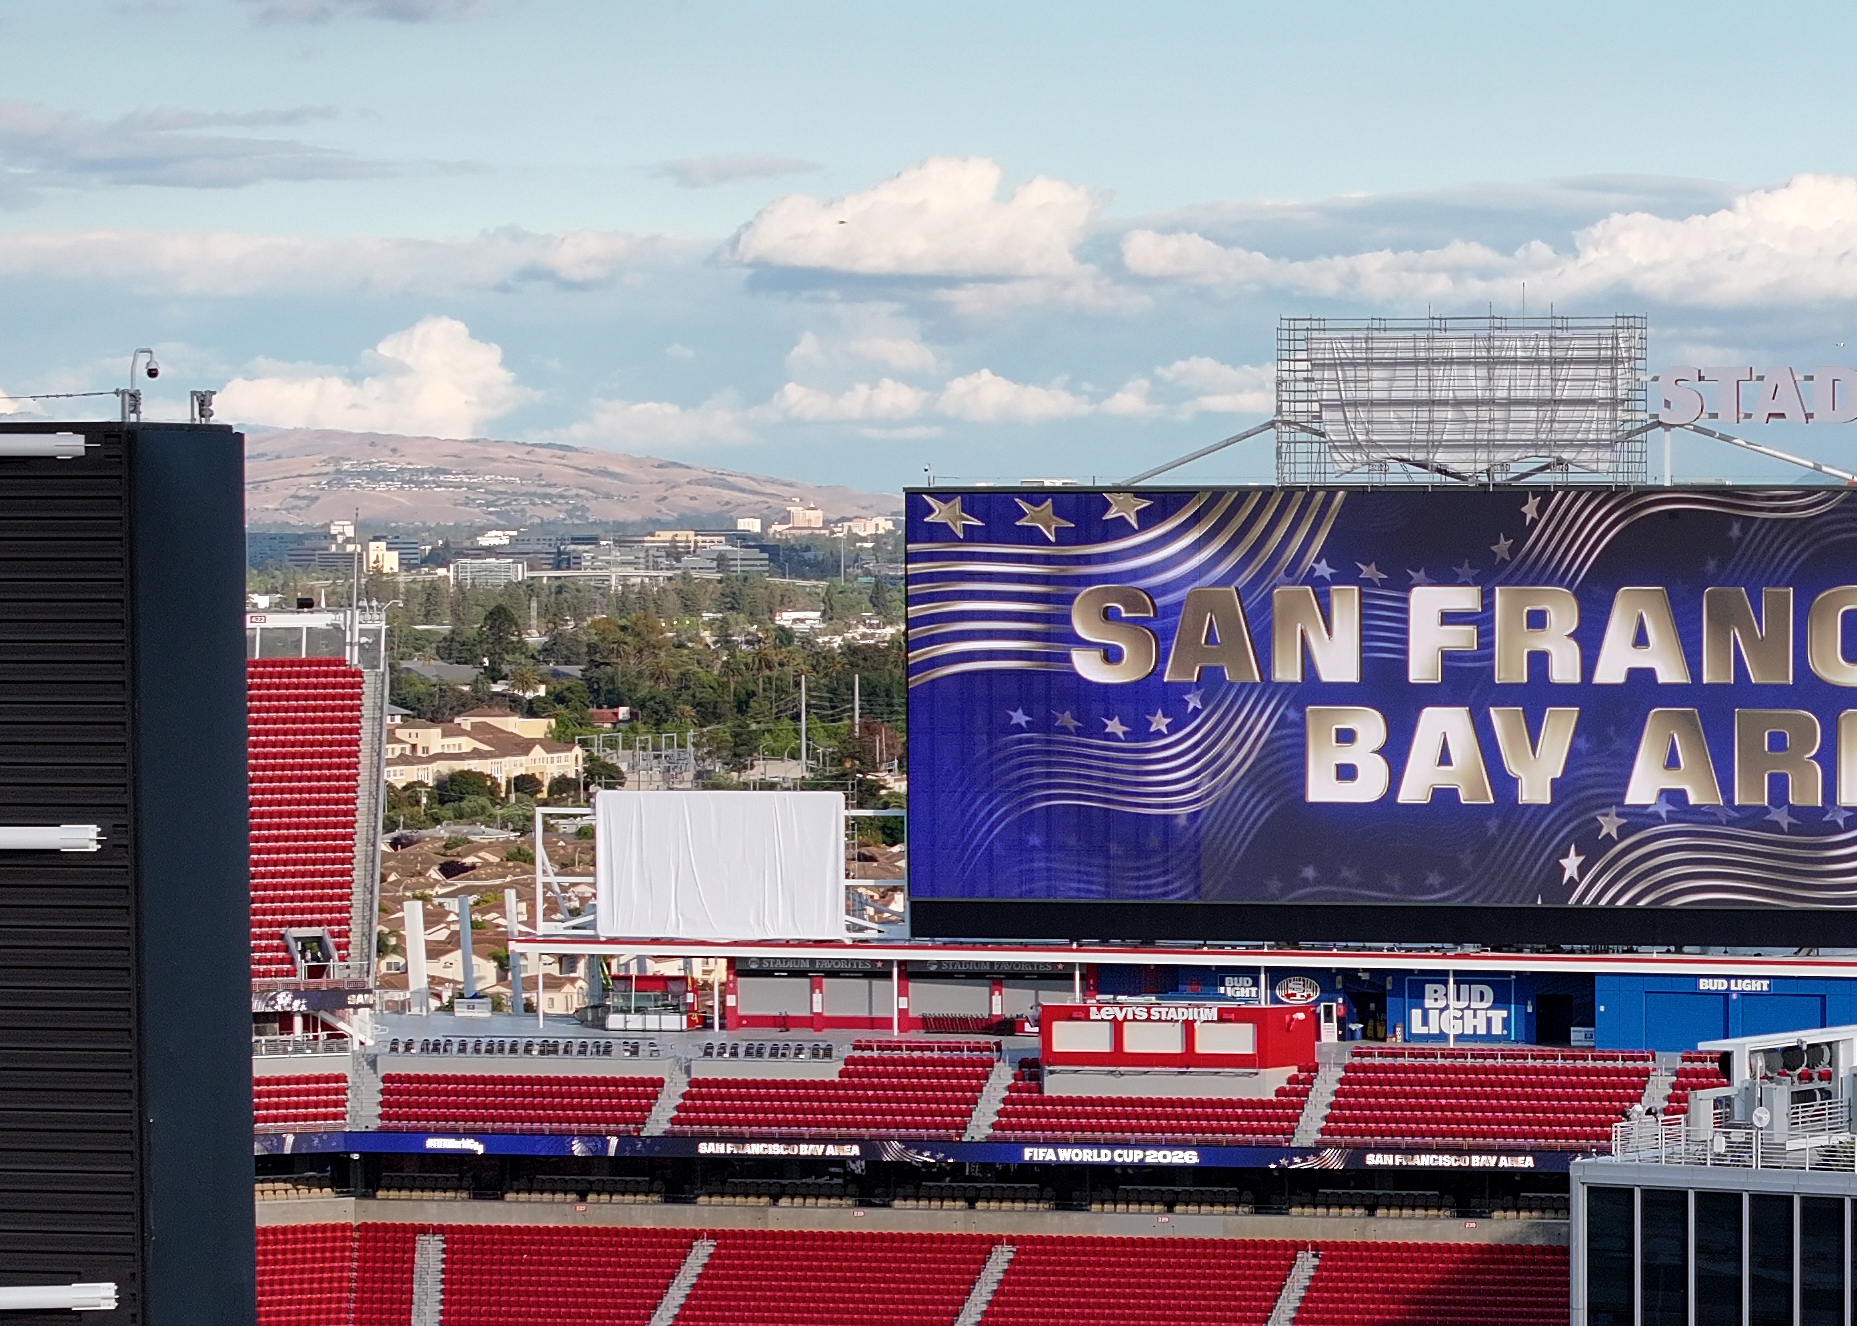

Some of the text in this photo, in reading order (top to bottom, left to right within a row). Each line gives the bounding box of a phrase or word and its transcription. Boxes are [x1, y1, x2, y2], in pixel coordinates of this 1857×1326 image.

[1070, 584, 1362, 686] SAN
[1302, 704, 1580, 805] BAY
[941, 960, 1053, 972] STADIUM FAVORITES
[1224, 976, 1253, 987] BUD
[1699, 979, 1770, 992] BUD LIGHT
[1425, 983, 1494, 1009] BUD
[1150, 1007, 1218, 1021] STADIUM
[1411, 1009, 1508, 1036] LIGHT
[698, 1142, 726, 1154] SAN
[800, 1144, 825, 1156] BAY
[1023, 1147, 1199, 1164] FIFA WORLD CUP 2026
[1365, 1153, 1394, 1165] SAN
[1471, 1155, 1498, 1167] BAY
